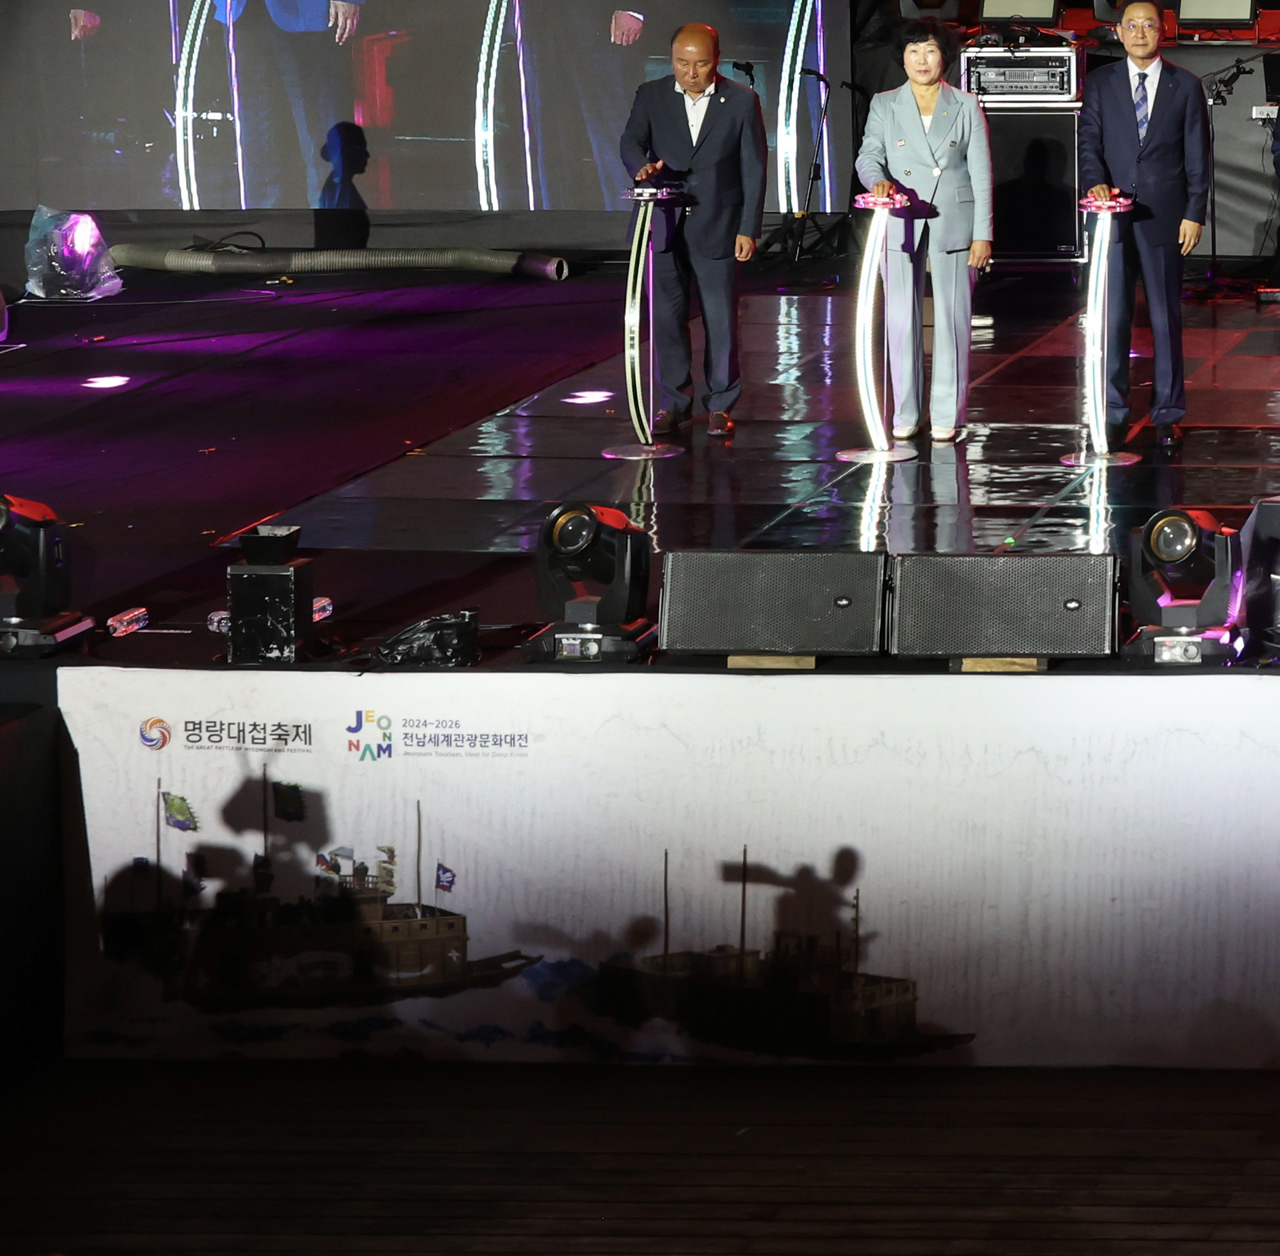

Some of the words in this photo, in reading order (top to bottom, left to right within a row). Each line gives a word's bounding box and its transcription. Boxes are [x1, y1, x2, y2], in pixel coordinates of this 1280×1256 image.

[402, 719, 461, 729] 2024~2026
[184, 720, 312, 746] 명량대첩축제
[402, 733, 528, 748] 전남세계관광문화대전
